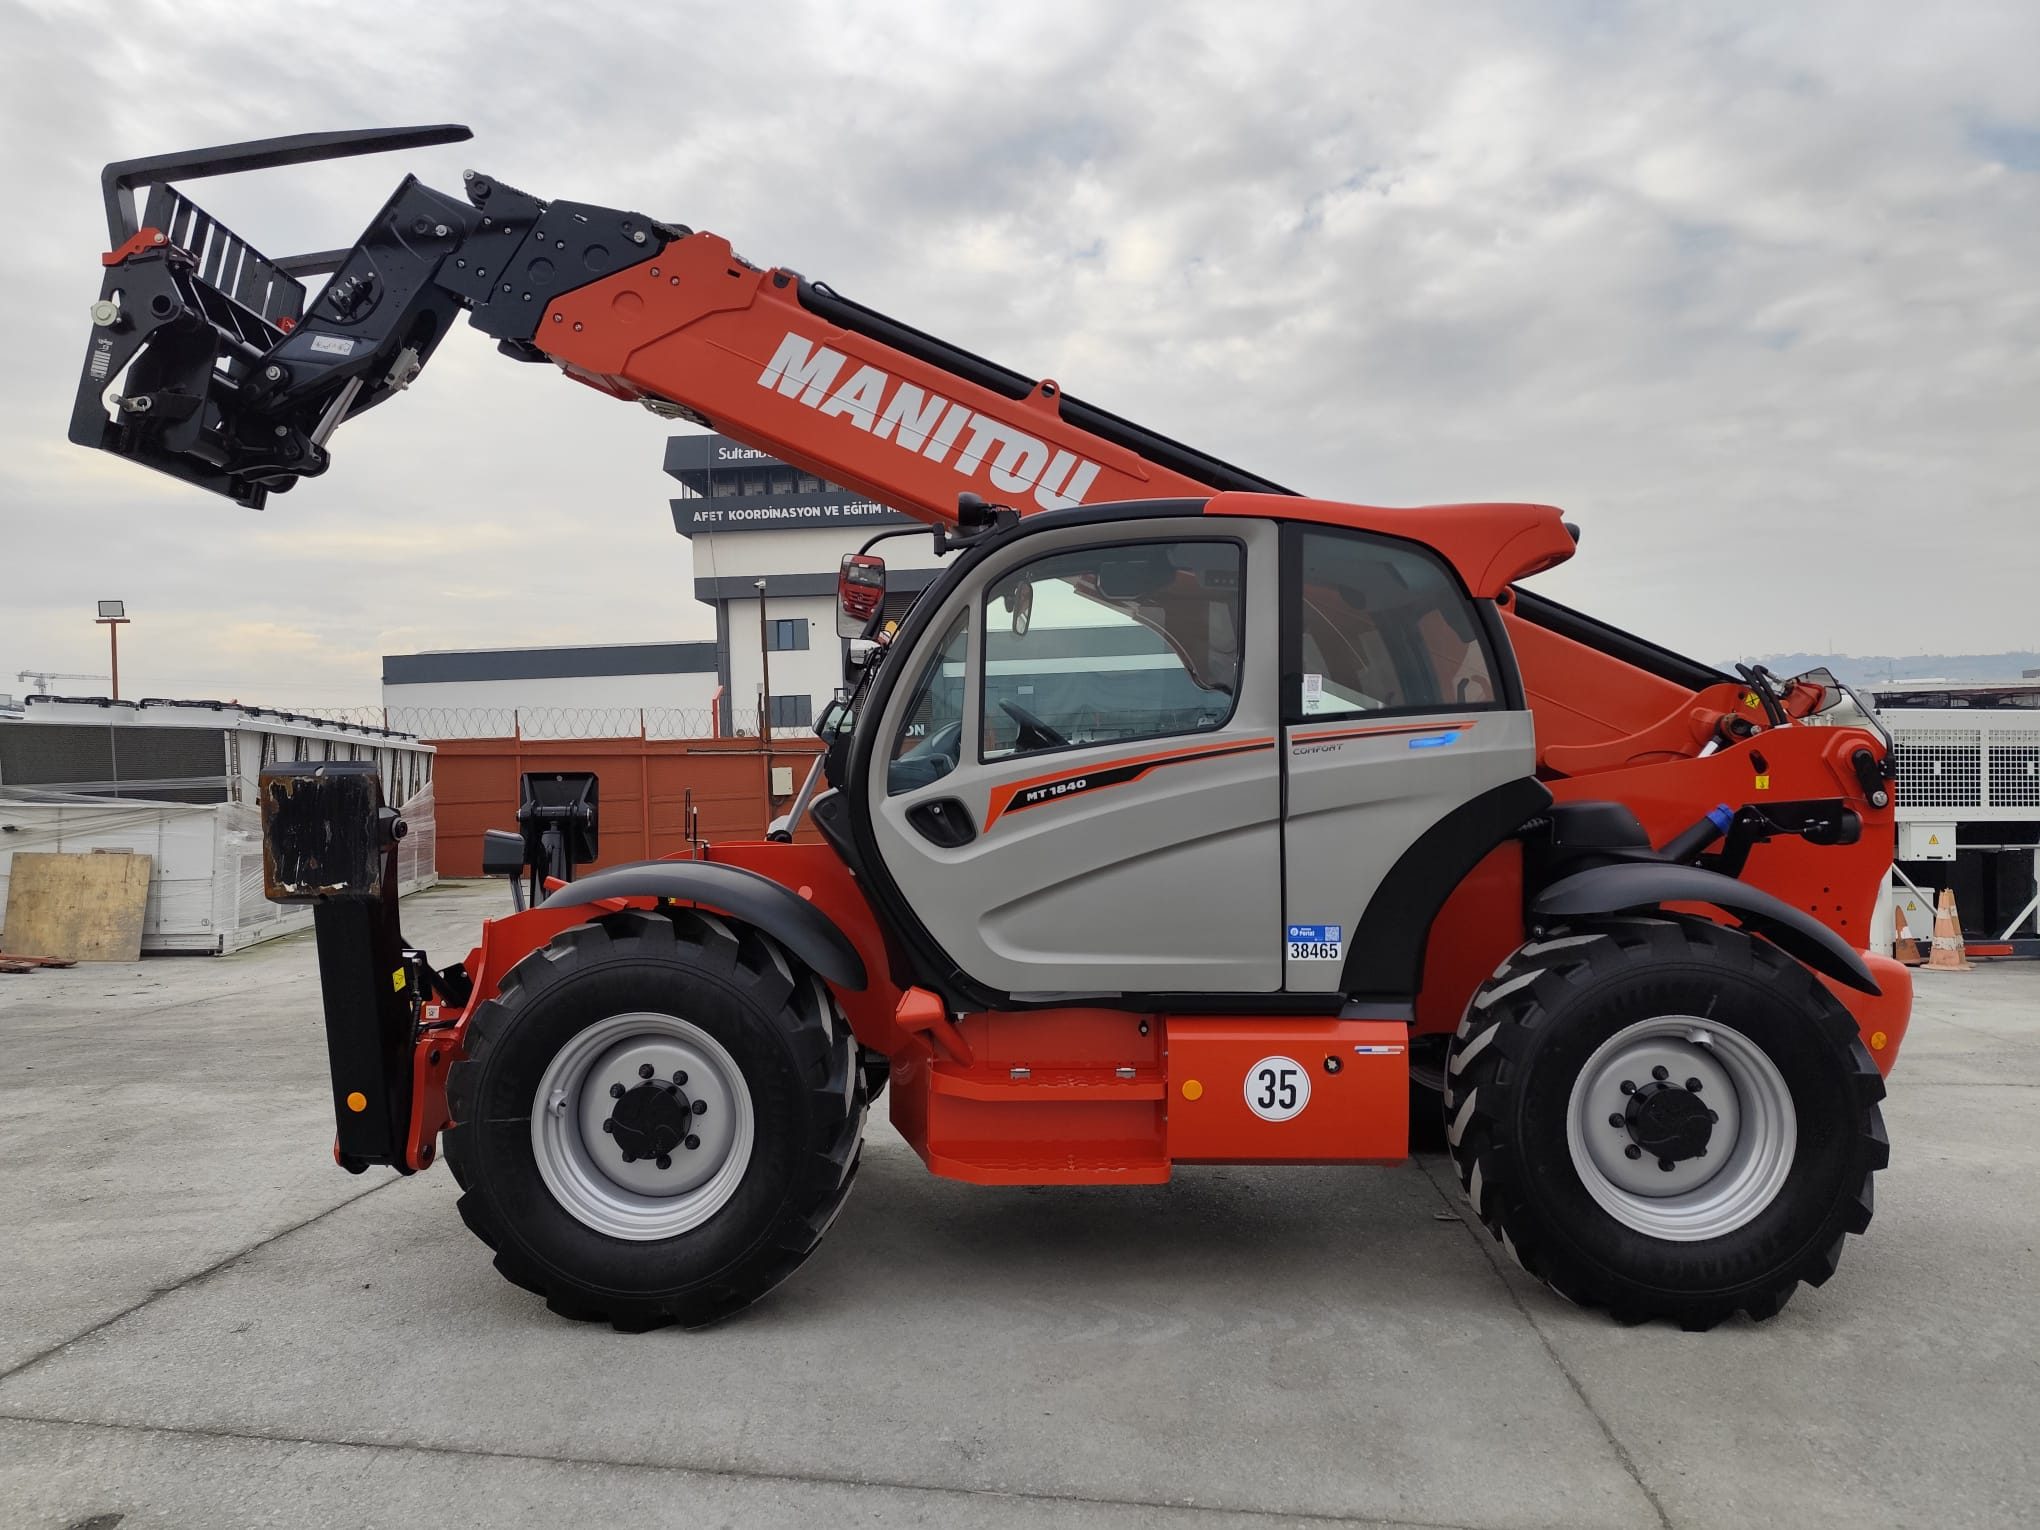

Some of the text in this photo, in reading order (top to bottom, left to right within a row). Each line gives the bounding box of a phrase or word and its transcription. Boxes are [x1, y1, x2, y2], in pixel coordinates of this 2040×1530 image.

[757, 331, 1101, 511] MANITOU
[693, 511, 723, 522] AFET
[728, 505, 821, 521] KOORDİNASYON
[823, 505, 839, 516] VE
[843, 500, 882, 515] EĞİTİM
[1292, 743, 1344, 756] COMFORT
[1026, 779, 1087, 801] MT 1840
[1291, 943, 1338, 958] 38465
[1258, 1069, 1297, 1109] 35
